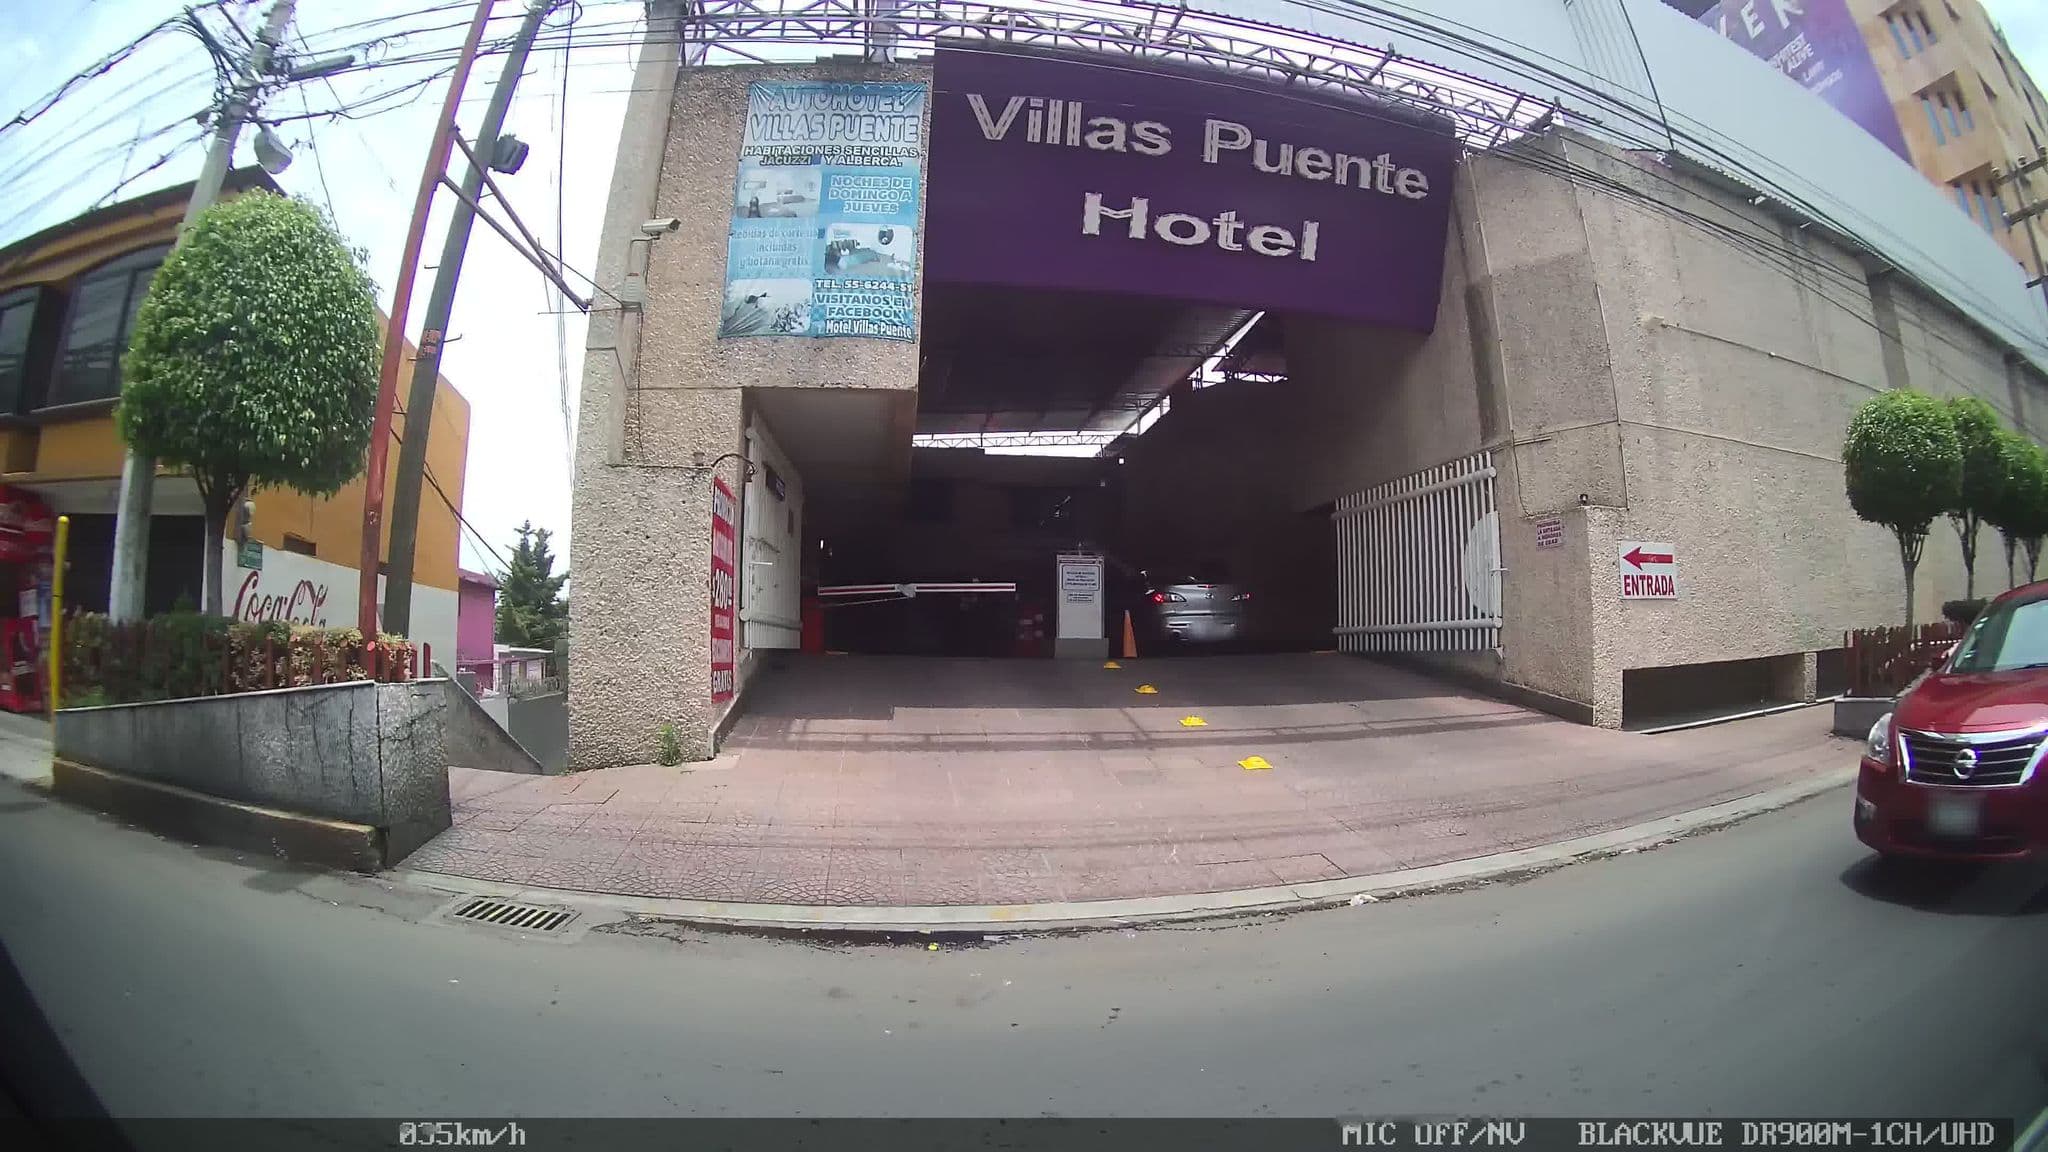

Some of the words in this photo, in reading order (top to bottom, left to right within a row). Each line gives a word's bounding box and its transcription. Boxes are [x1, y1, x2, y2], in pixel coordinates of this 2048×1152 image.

[769, 84, 905, 113] AUTOHOTEL
[751, 114, 825, 141] VILLAS
[829, 114, 919, 143] PUENTE
[744, 145, 841, 156] HABITACIONES
[966, 94, 1172, 156] Villas
[1202, 118, 1430, 200] Puente
[760, 156, 812, 166] JACUZZI
[824, 155, 834, 165] Y
[831, 176, 890, 188] NOCHES
[891, 178, 912, 189] DE
[829, 189, 899, 201] DOMINGO
[900, 190, 911, 202] A
[843, 201, 898, 214] JUEVES
[1081, 191, 1319, 261] Hotel
[827, 305, 905, 319] FACEBOOK
[853, 319, 879, 335] Villas
[880, 321, 912, 339] Puente
[1623, 575, 1675, 596] ENTRADA
